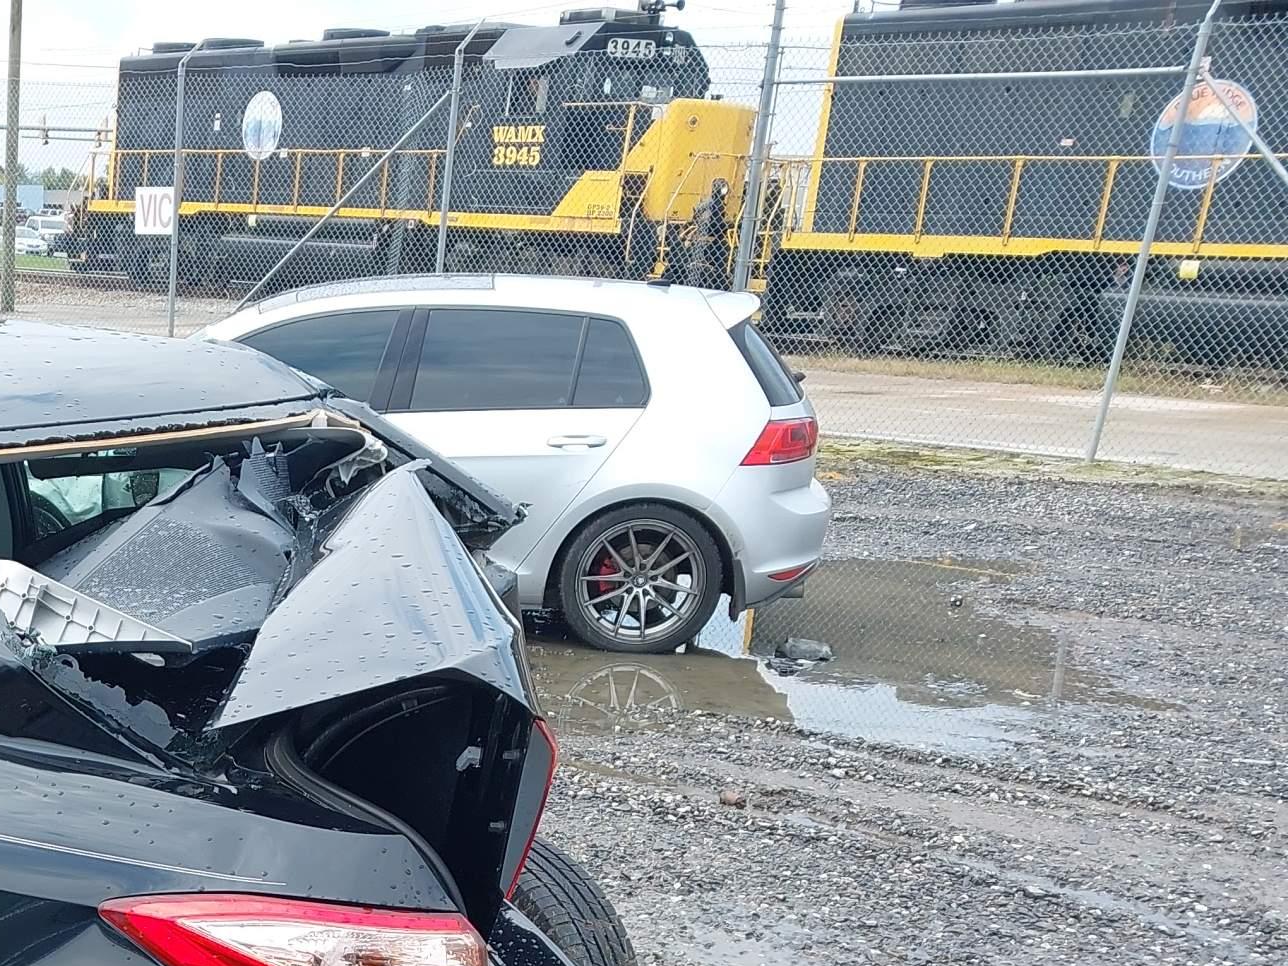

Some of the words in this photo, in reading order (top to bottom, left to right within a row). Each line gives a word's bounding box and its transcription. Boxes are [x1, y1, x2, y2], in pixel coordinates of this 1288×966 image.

[610, 39, 653, 57] 3945
[493, 125, 545, 143] WAMX
[493, 145, 541, 166] 3945
[139, 193, 172, 228] VIC
